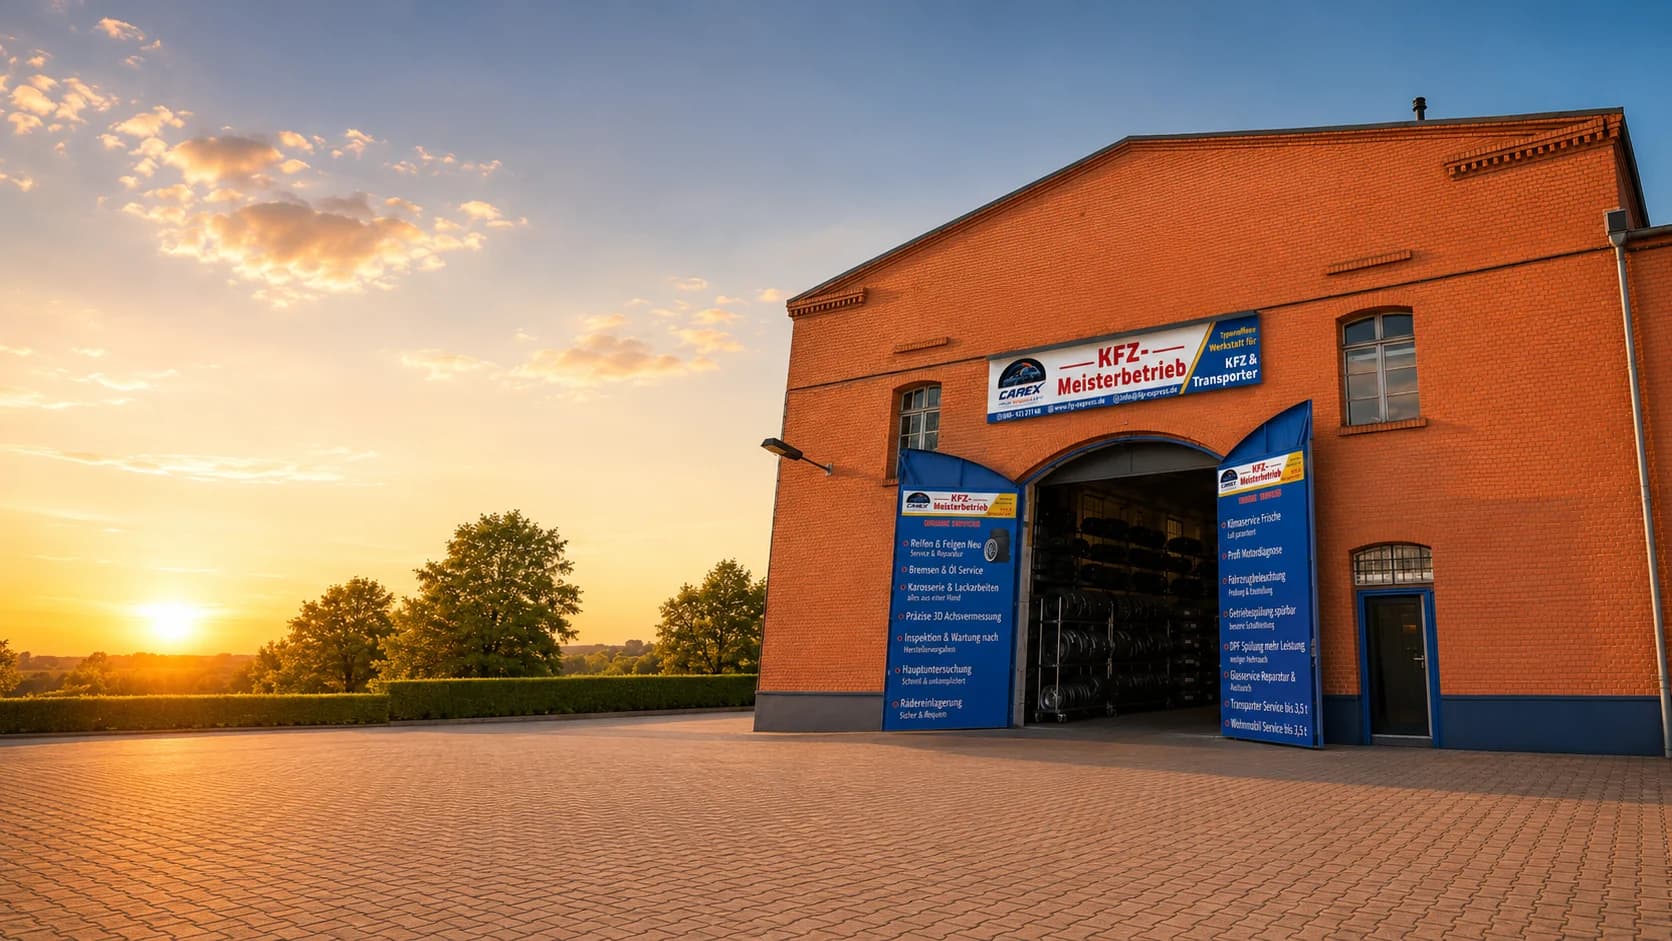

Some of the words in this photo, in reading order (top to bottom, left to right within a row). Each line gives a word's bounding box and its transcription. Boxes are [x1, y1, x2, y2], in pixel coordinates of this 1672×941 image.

[1209, 339, 1244, 352] Werkstatt
[1246, 337, 1257, 346] für
[1098, 342, 1148, 368] KFZ-
[1225, 354, 1247, 369] KFZ
[1249, 353, 1257, 365] &
[1058, 358, 1186, 395] Meisterbetrieb
[1192, 368, 1258, 387] Transporter
[999, 382, 1045, 400] CAREX
[1252, 462, 1269, 473] KFZ-
[1240, 469, 1282, 485] Meisterbetrieb
[951, 494, 972, 502] KFZ-
[933, 502, 988, 511] Meisterbetrieb
[1227, 515, 1260, 529] Klimaservice
[1261, 511, 1281, 523] Frische
[910, 539, 933, 548] Reifen
[935, 540, 941, 548] &
[943, 539, 966, 550] Felgen
[967, 540, 982, 549] Neu
[1228, 548, 1241, 560] Profi
[1241, 546, 1283, 558] Motordiagnose
[909, 565, 939, 574] Bremsen
[941, 566, 947, 574] &
[949, 564, 957, 574] Öl
[959, 565, 984, 575] Service
[1228, 571, 1286, 586] Fahrzeugbeleuchtung
[907, 583, 945, 592] Karosserie
[947, 583, 952, 592] &
[954, 583, 999, 592] Lackarbeiten
[905, 611, 932, 620] Präzise
[934, 612, 943, 620] 3D
[944, 612, 1002, 623] Achsvermessung
[1229, 606, 1274, 620] Getriebespülung
[1274, 605, 1297, 618] spürbar
[904, 633, 942, 643] Inspektion
[943, 633, 949, 641] &
[951, 633, 981, 644] Wartung
[982, 632, 999, 641] nach
[1229, 641, 1240, 652] DPF
[1241, 641, 1264, 654] Spülung
[1264, 640, 1280, 651] mehr
[1280, 640, 1306, 653] Leistung
[902, 664, 972, 676] Hauptuntersuchung
[1230, 670, 1260, 681] Glasservice
[1261, 671, 1290, 684] Reparatur
[1291, 671, 1296, 682] &
[900, 698, 963, 709] Rädereinlagerung
[1230, 698, 1262, 712] Transporter
[1263, 700, 1284, 713] Service
[1284, 702, 1294, 713] bis
[1294, 703, 1304, 715] 3,5
[1304, 704, 1308, 714] t
[900, 711, 916, 719] Sicher
[1230, 718, 1262, 731] Wohnmobil
[1262, 721, 1283, 734] Service
[1284, 723, 1293, 734] bis
[1294, 725, 1304, 737] 3,5
[1304, 726, 1308, 736] t
